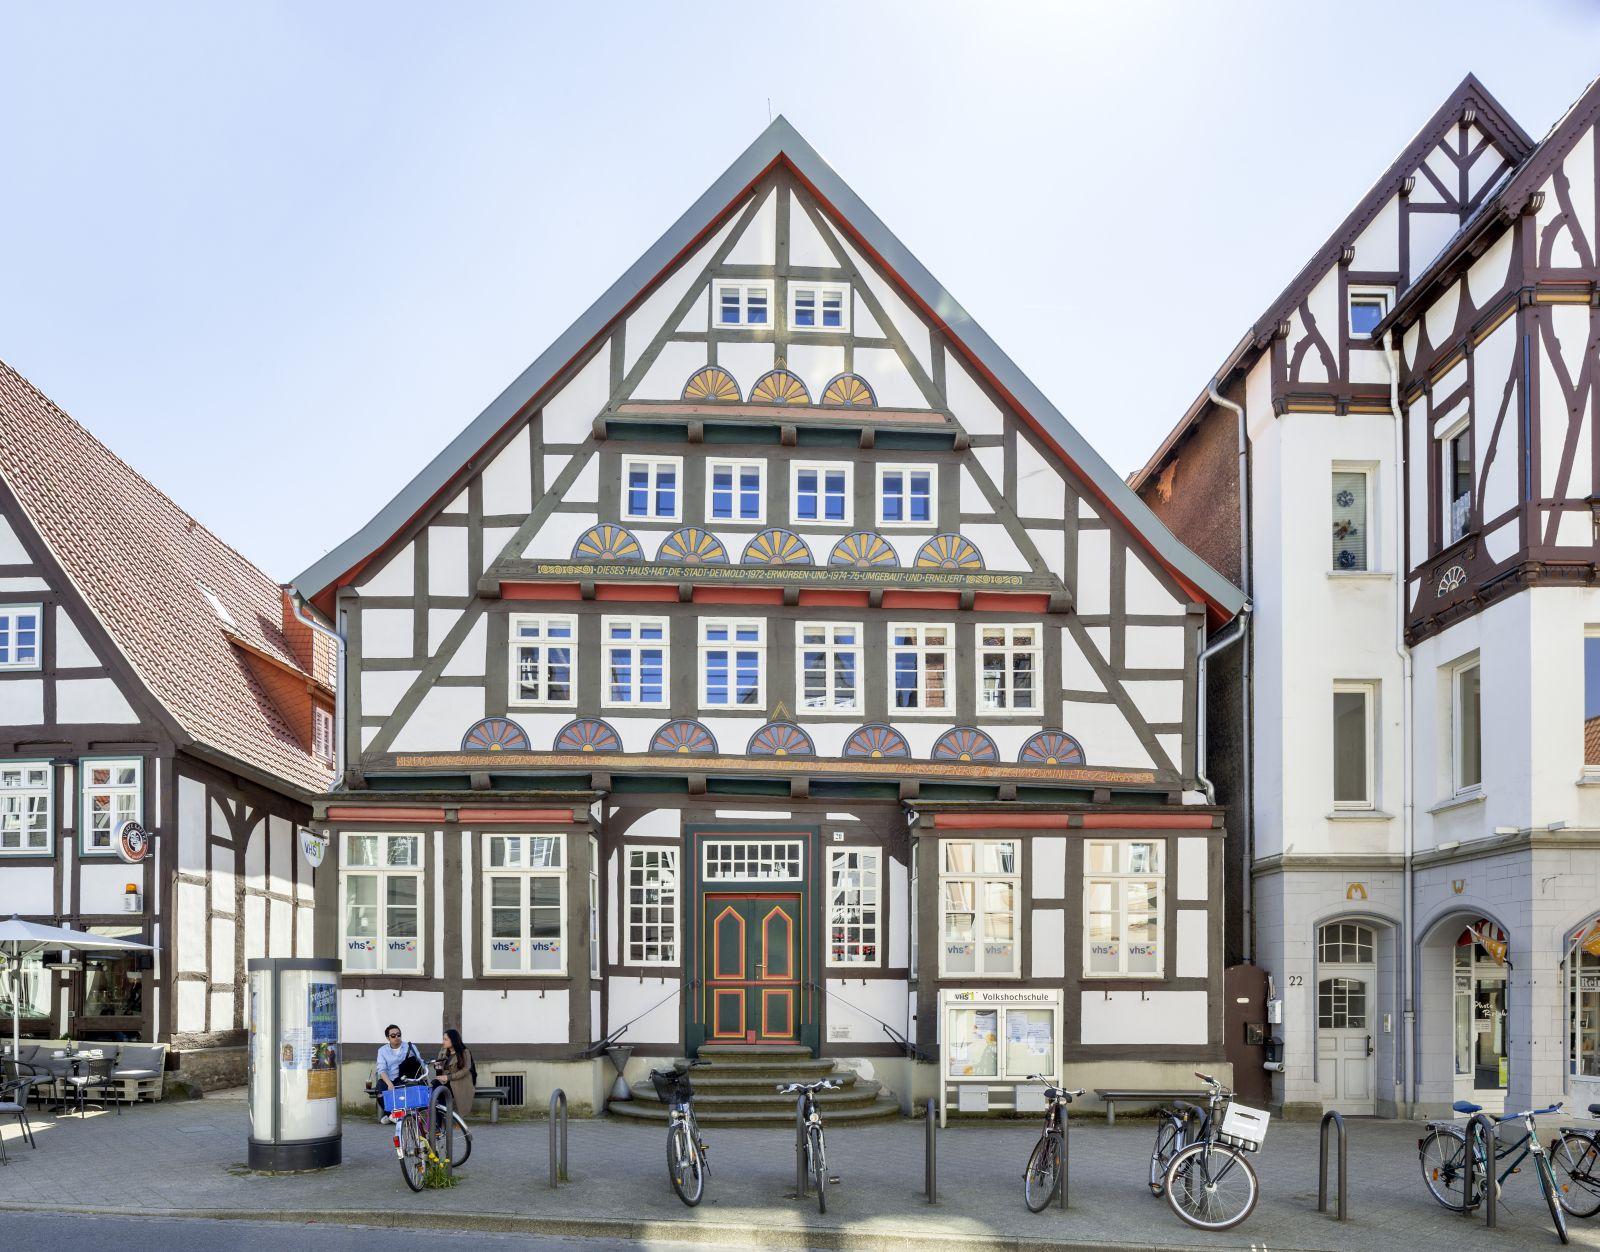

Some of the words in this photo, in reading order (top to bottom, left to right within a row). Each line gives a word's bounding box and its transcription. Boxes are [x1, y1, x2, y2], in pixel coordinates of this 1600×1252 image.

[596, 565, 625, 574] DIESES
[626, 566, 649, 575] HAUS
[651, 566, 666, 576] HAT
[668, 567, 681, 576] DIE
[683, 567, 707, 577] STADT
[709, 568, 745, 578] DETMOLD
[747, 569, 765, 579] 1972
[767, 570, 809, 580] ERWORBEN
[811, 571, 828, 580] UND
[830, 571, 860, 580] 1974-75
[862, 572, 904, 582] UMGEBAUT
[905, 573, 922, 582] UND
[924, 573, 963, 583] ERNEUERT
[304, 840, 317, 856] VHS
[348, 940, 365, 950] vhs
[389, 940, 405, 950] vhs
[492, 941, 509, 951] vhs
[532, 941, 549, 951] vhs
[947, 945, 964, 954] vhs
[1091, 945, 1108, 954] vhs
[1129, 945, 1146, 955] vhs
[985, 946, 1002, 955] vhs
[1288, 975, 1303, 986] 22
[982, 992, 1049, 1001] Volkshochschule
